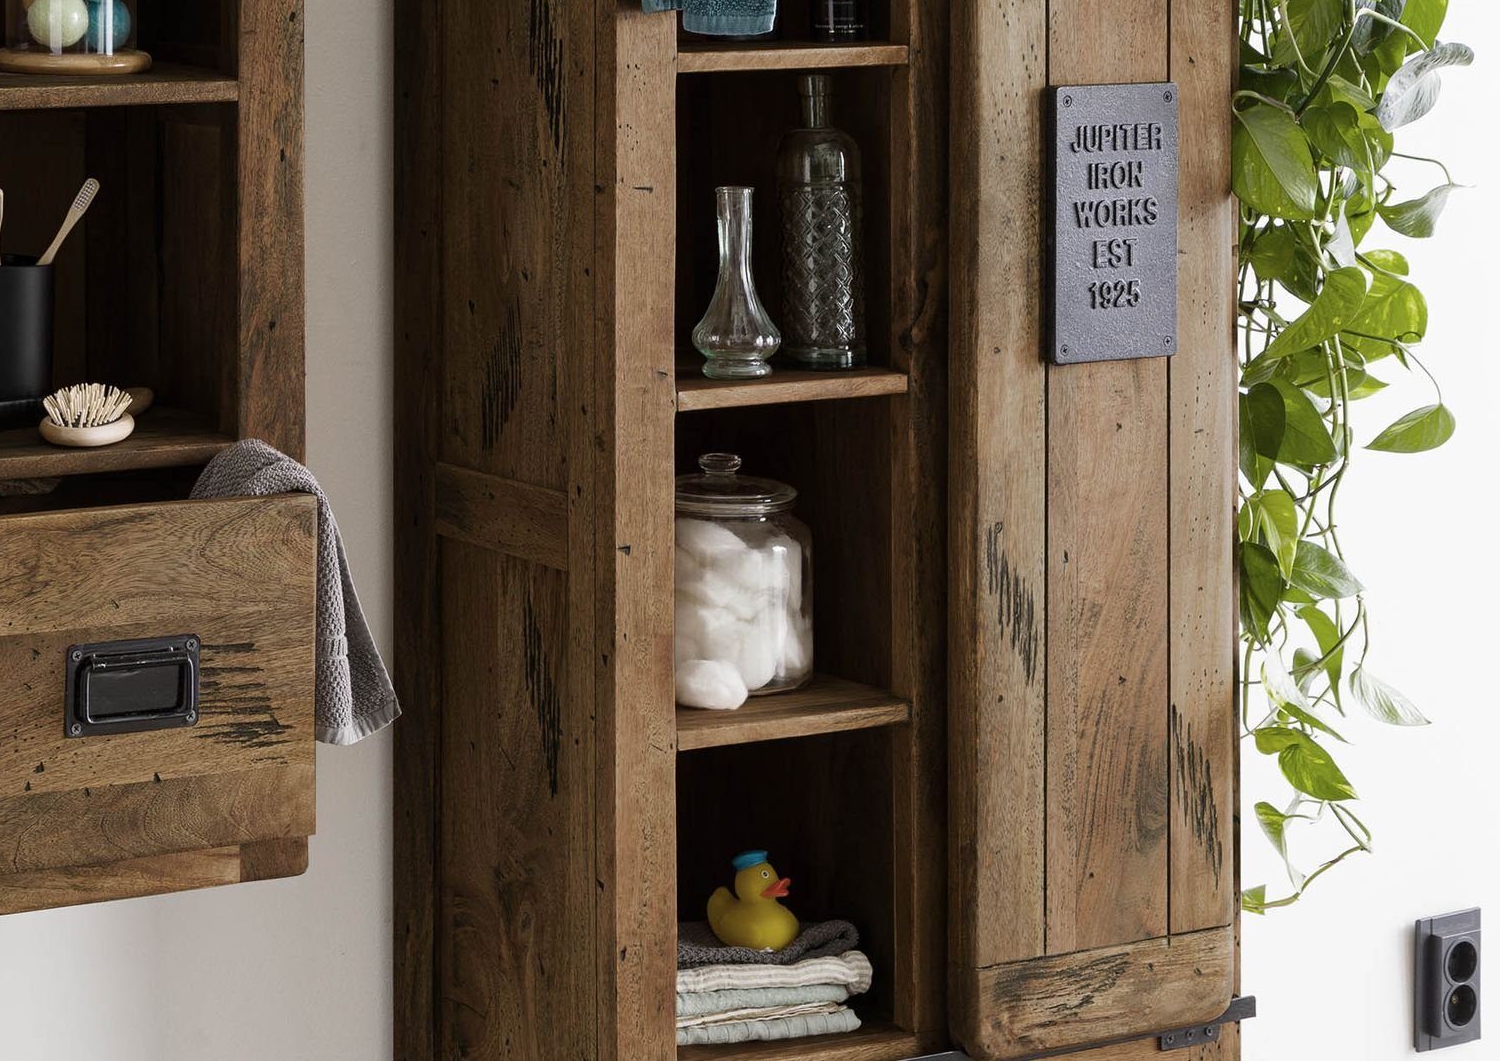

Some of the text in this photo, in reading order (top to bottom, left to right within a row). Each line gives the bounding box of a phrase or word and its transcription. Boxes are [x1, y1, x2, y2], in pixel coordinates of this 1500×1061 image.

[1070, 123, 1163, 153] JUPITER
[1087, 160, 1143, 191] IRON
[1073, 196, 1159, 229] WORKS
[1092, 238, 1139, 269] EST
[1088, 279, 1142, 310] 1925
